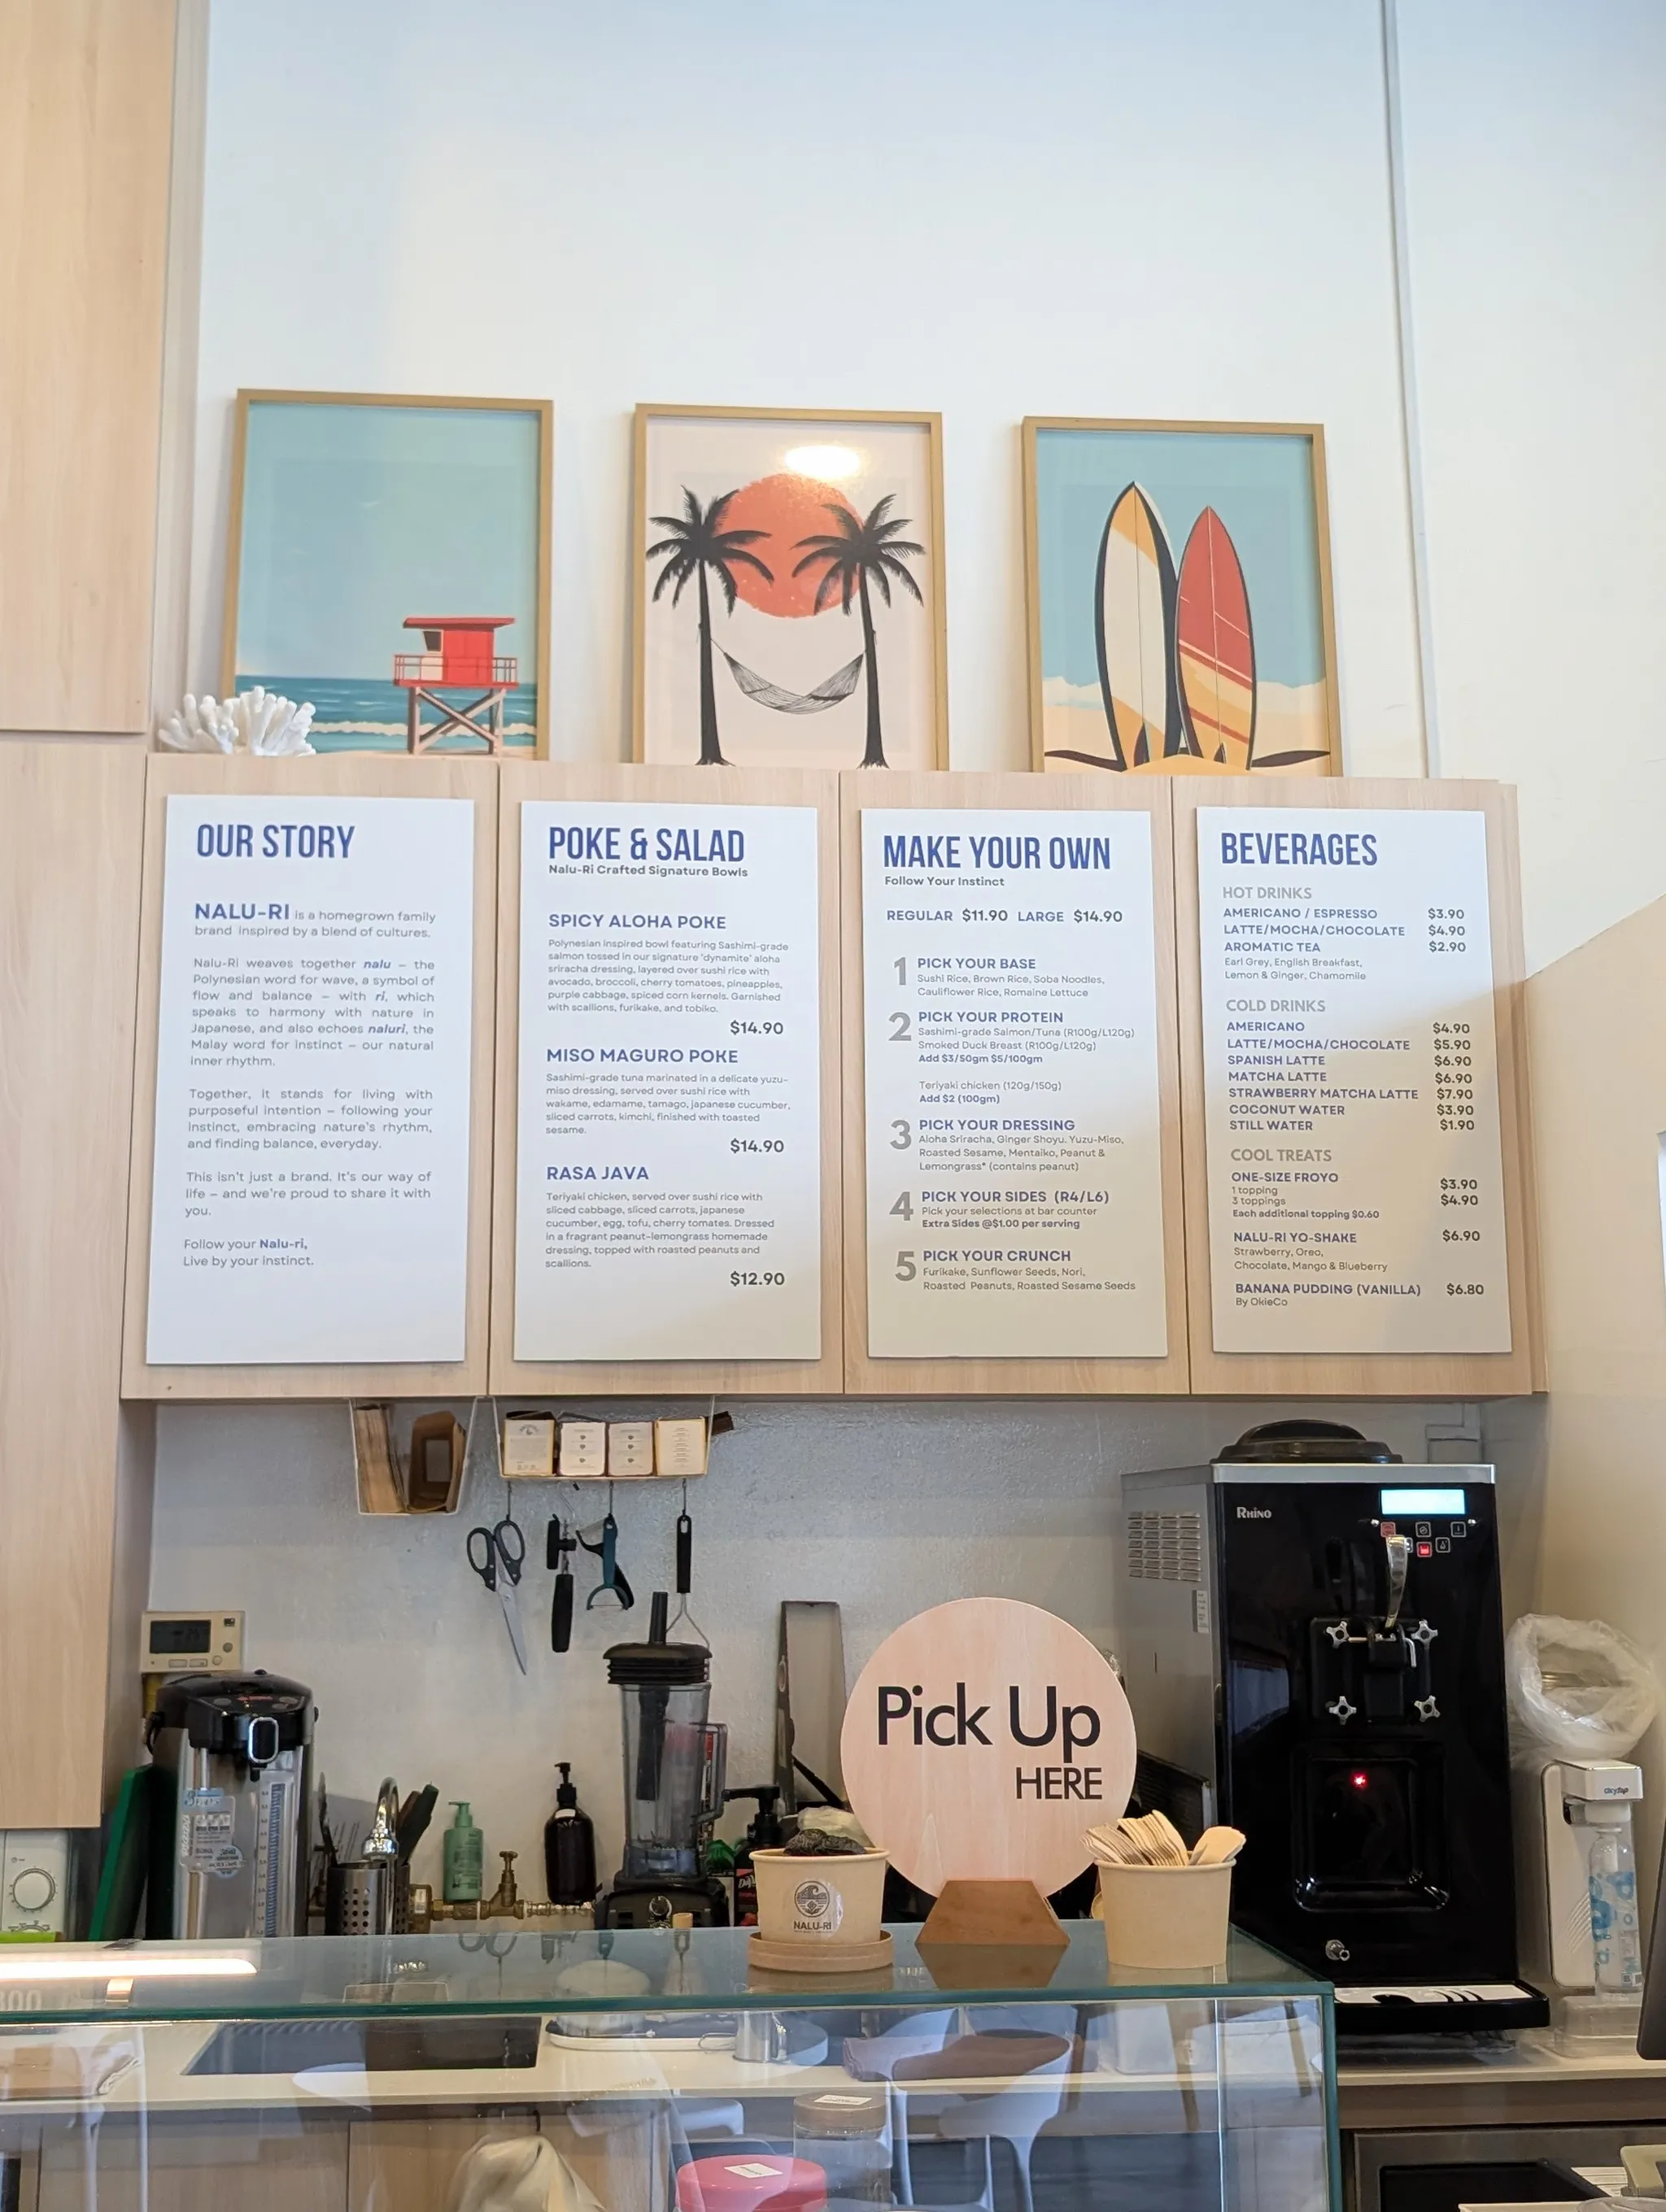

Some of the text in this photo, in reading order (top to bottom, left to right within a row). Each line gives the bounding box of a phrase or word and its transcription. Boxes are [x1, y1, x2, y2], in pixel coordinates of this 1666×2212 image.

[197, 824, 355, 858] OUR STORY
[549, 826, 744, 862] POKE & SALAD
[883, 835, 1110, 869] MAKE YOUR OWN
[1221, 832, 1377, 865] BEVERAGES
[549, 864, 748, 877] Nalu-Ri Crafted Signature Bowls
[885, 875, 1004, 886] Follow Your Instinct
[1223, 886, 1311, 899] HOT DRINKS
[194, 903, 289, 920] NALU-RI
[295, 910, 303, 919] is
[319, 911, 394, 921] homegrown
[398, 912, 435, 923] family
[887, 908, 1122, 923] REGULAR $11.90 LARGE $14.90
[1223, 908, 1301, 917] AMERICANO
[1314, 908, 1377, 918] ESPRESSO
[1428, 907, 1464, 920] $3.90
[548, 913, 726, 929] SPICY ALOHA POKE
[1223, 924, 1465, 936] LATTE/MOCHA/CHOCOLATE $4.90
[1223, 940, 1466, 952] AROMATIC TEA $2.90
[918, 957, 1036, 969] PICK YOUR BASE
[1224, 957, 1362, 968] Earl Grey, English Breakfast,
[893, 956, 906, 985] 1
[1226, 999, 1325, 1012] COLD DRINKS
[918, 1011, 1062, 1022] PICK YOUR PROTEIN
[730, 1019, 783, 1035] $14.90
[888, 1012, 911, 1041] 2
[1227, 1021, 1470, 1034] AMERICANO $4.90
[1228, 1038, 1470, 1051] LATTE/MOCHA/CHOCOLATE $5.90
[547, 1048, 738, 1063] MISO MAGURO POKE
[918, 1053, 1042, 1065] Add $3/50gm $5/100gm
[1228, 1054, 1471, 1067] SPANISH LATTE $6.90
[1228, 1071, 1472, 1084] MATCHA LATTE $6.90
[919, 1093, 1000, 1104] Add $2 (100gm)
[1228, 1086, 1472, 1100] STRAWBERRY MATCHA LATTE $7.90
[1229, 1103, 1473, 1116] COCONUT WATER $3.90
[919, 1119, 1075, 1130] PICK YOUR DRESSING
[1229, 1118, 1474, 1131] STILL WATER $1.90
[889, 1119, 911, 1150] 3
[730, 1137, 784, 1154] $14.90
[1230, 1148, 1332, 1161] COOL TREATS
[547, 1166, 648, 1180] RASA JAVA
[1231, 1172, 1338, 1182] ONE-SIZE FROYO
[1232, 1178, 1477, 1195] 1 topping $3.90
[546, 1192, 585, 1202] Teriyaki
[587, 1192, 630, 1201] chicken,
[632, 1192, 665, 1200] served
[692, 1192, 717, 1200] sushi
[720, 1192, 739, 1201] rice
[740, 1192, 762, 1200] with
[922, 1190, 1109, 1204] PICK YOUR SIDES (R4/L6)
[1232, 1193, 1478, 1207] 3 toppings $4.90
[889, 1191, 914, 1221] 4
[1232, 1208, 1379, 1220] Each additional topping $0.60
[922, 1218, 1079, 1230] Extra Sides @$1.00 per serving
[1234, 1229, 1480, 1243] NALU-RI YO-SHAKE $6.90
[184, 1238, 307, 1251] Follow your Nalu-ri,
[183, 1255, 313, 1269] Live by your instinct.
[923, 1250, 1071, 1261] PICK YOUR CRUNCH
[895, 1251, 916, 1281] 5
[730, 1270, 784, 1287] $12.90
[1235, 1282, 1484, 1296] BANANA PUDDING (VANILLA) $6.80
[1236, 1297, 1288, 1308] By OkieCo
[879, 1683, 1100, 1763] Pick Up
[1017, 1768, 1101, 1799] HERE
[793, 1921, 832, 1930] NALU-RI
